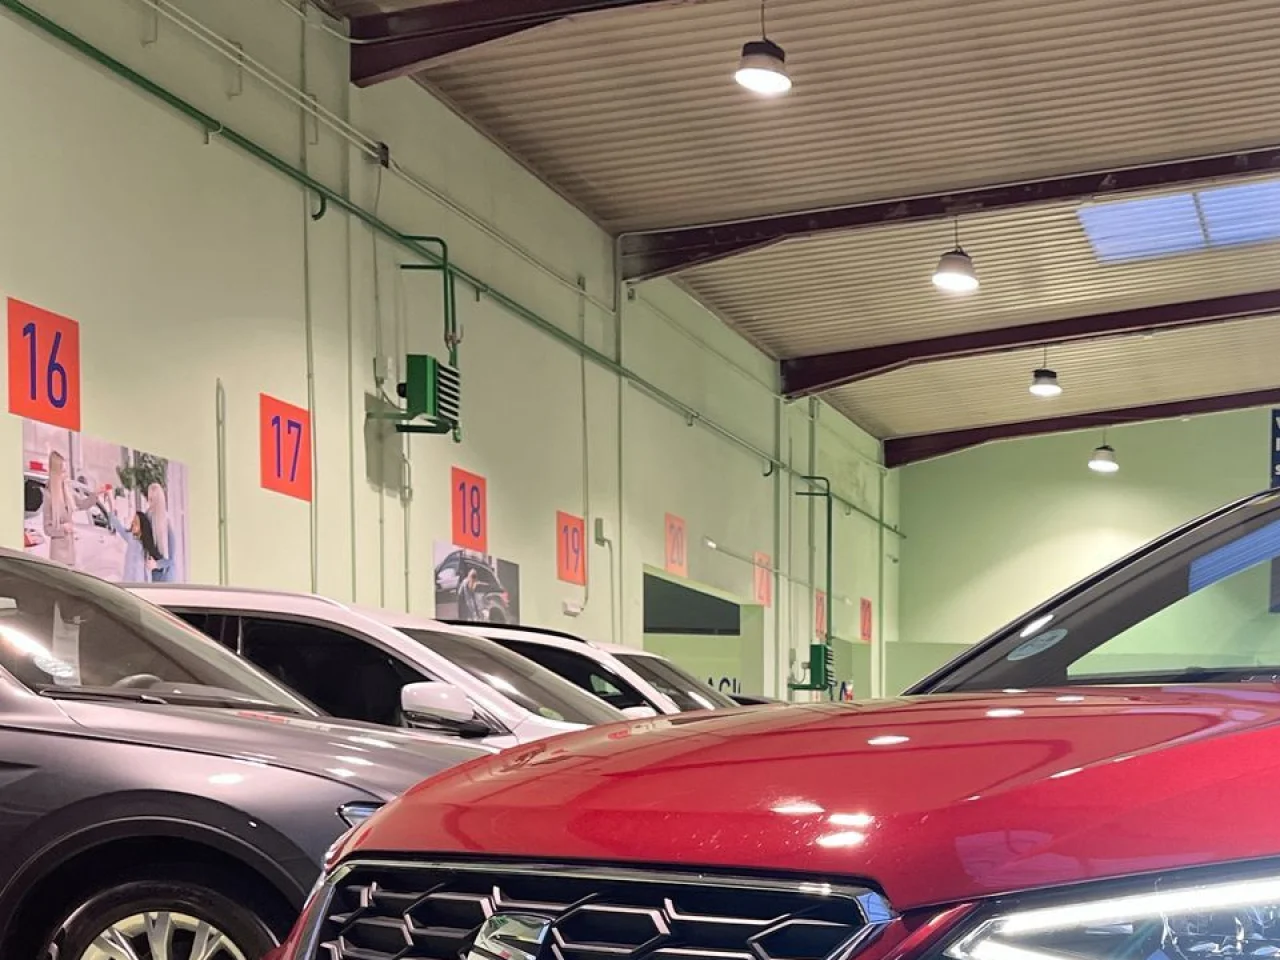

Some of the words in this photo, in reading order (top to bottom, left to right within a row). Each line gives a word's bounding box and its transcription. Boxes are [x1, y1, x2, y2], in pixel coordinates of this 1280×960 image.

[23, 322, 68, 409] 16
[271, 415, 302, 482] 17
[459, 481, 481, 538] 18
[563, 525, 580, 574] 19
